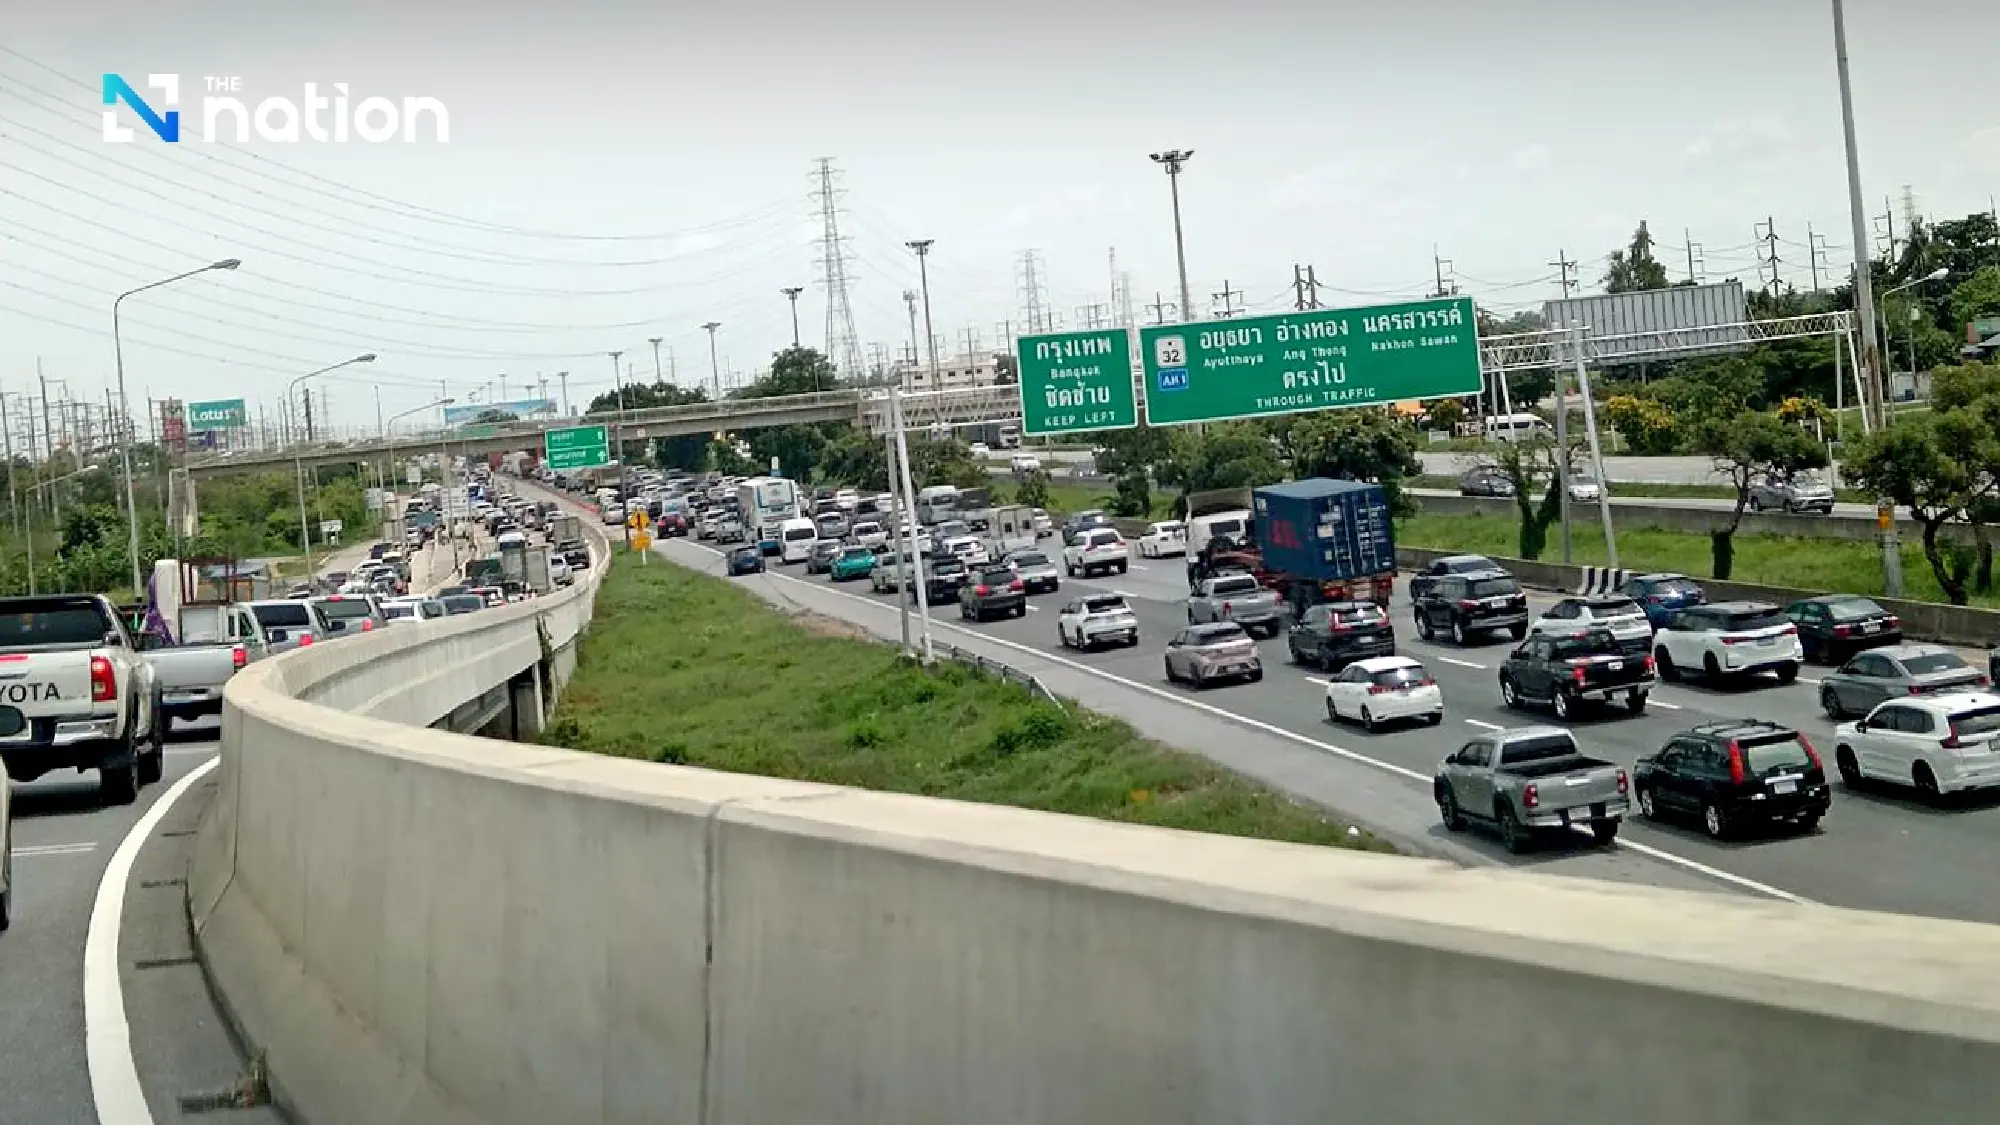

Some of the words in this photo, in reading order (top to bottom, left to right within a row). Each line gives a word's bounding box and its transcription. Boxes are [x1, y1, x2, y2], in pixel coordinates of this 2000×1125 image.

[1200, 327, 1262, 353] อยุธยา
[1277, 318, 1349, 343] อ่างทอง
[1363, 302, 1462, 333] นครสวรรค์
[1037, 337, 1112, 364] กรุงเทพ
[1162, 350, 1181, 363] 32
[1283, 349, 1307, 361] Ang
[1312, 346, 1346, 358] Thong
[1371, 340, 1415, 352] Nakhon
[1282, 360, 1346, 389] ตรงไป
[1254, 394, 1313, 409] THROUGH
[1322, 387, 1375, 402] TRAFFIC
[1044, 414, 1076, 427] KEEP
[1084, 411, 1115, 424] LEFT
